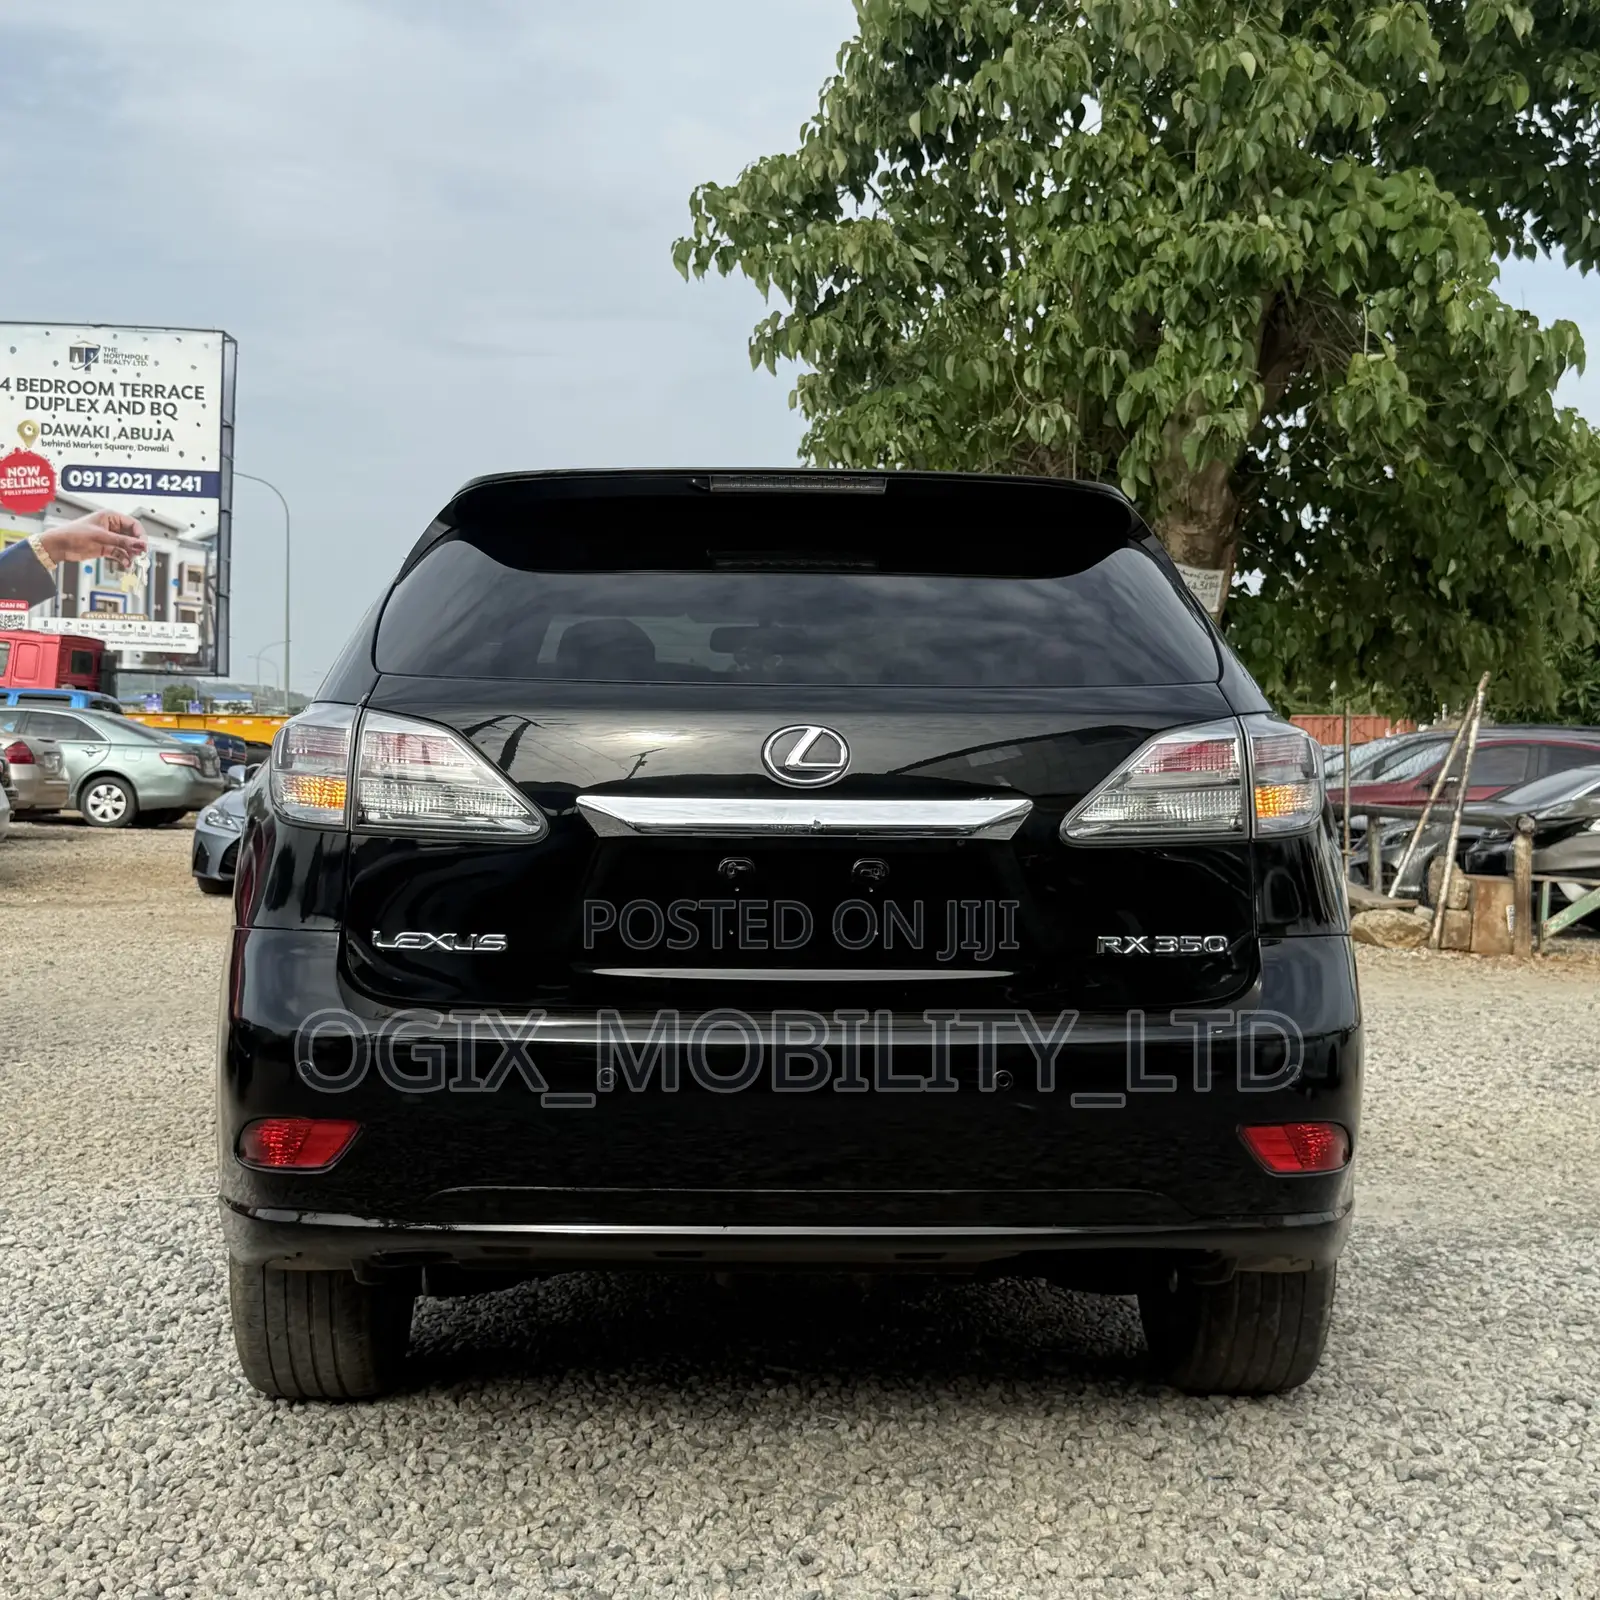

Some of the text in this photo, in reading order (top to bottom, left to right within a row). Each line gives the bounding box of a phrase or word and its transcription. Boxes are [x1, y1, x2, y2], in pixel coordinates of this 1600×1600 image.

[103, 352, 149, 361] NORTHPOLE
[103, 358, 131, 366] REALTY
[0, 377, 205, 400] 4 BEDROOM TERRACE
[25, 395, 178, 421] DUPLEX AND BQ
[40, 422, 109, 439] DAWAKI
[41, 439, 170, 453] behind Market Square, Dawaki
[7, 465, 40, 478] NOW
[0, 476, 50, 489] SELLING
[68, 470, 202, 492] 091 2021 4241
[372, 929, 508, 951] LEXUS
